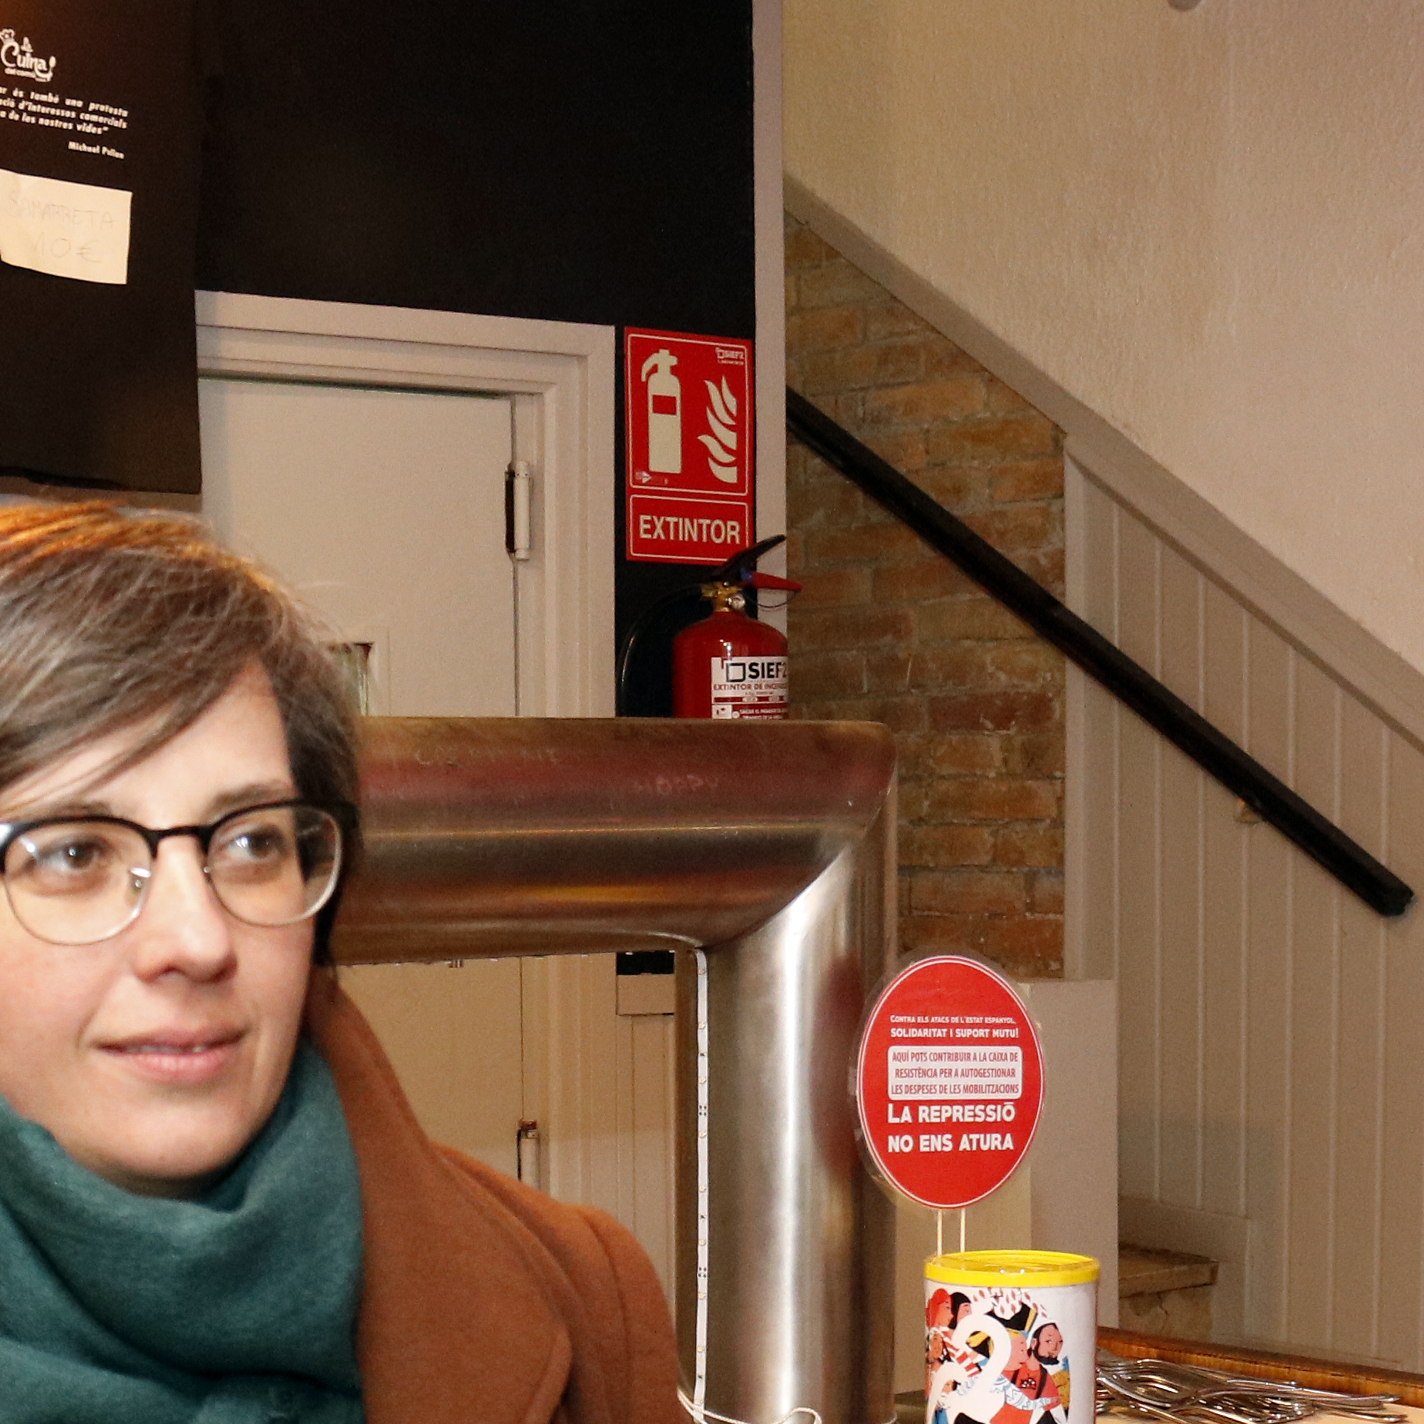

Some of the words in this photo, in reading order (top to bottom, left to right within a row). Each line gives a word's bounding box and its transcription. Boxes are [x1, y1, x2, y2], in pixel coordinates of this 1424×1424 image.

[639, 515, 740, 544] EXTINTOR
[890, 1028, 947, 1038] SOLIDARITAT
[956, 1028, 990, 1038] SUPORT
[992, 1028, 1019, 1039] MUTU!
[911, 1052, 928, 1062] POTS
[929, 1052, 971, 1062] CONTRIBUIR
[972, 1052, 978, 1062] A
[979, 1052, 987, 1062] LA
[988, 1052, 1008, 1062] CAIXA
[1009, 1052, 1018, 1062] DE
[939, 1069, 953, 1078] PER
[954, 1069, 959, 1078] A
[960, 1068, 1016, 1078] AUTOGESTIONAR
[891, 1085, 903, 1095] LES
[904, 1084, 937, 1095] DESPESES
[938, 1084, 948, 1095] DE
[949, 1084, 962, 1095] LES
[963, 1084, 1019, 1095] MOBILITZACIONS
[918, 1102, 1016, 1123] REPRESSIÓ
[887, 1134, 913, 1153] NO
[919, 1134, 953, 1152] ENS
[959, 1133, 1014, 1151] ATURA
